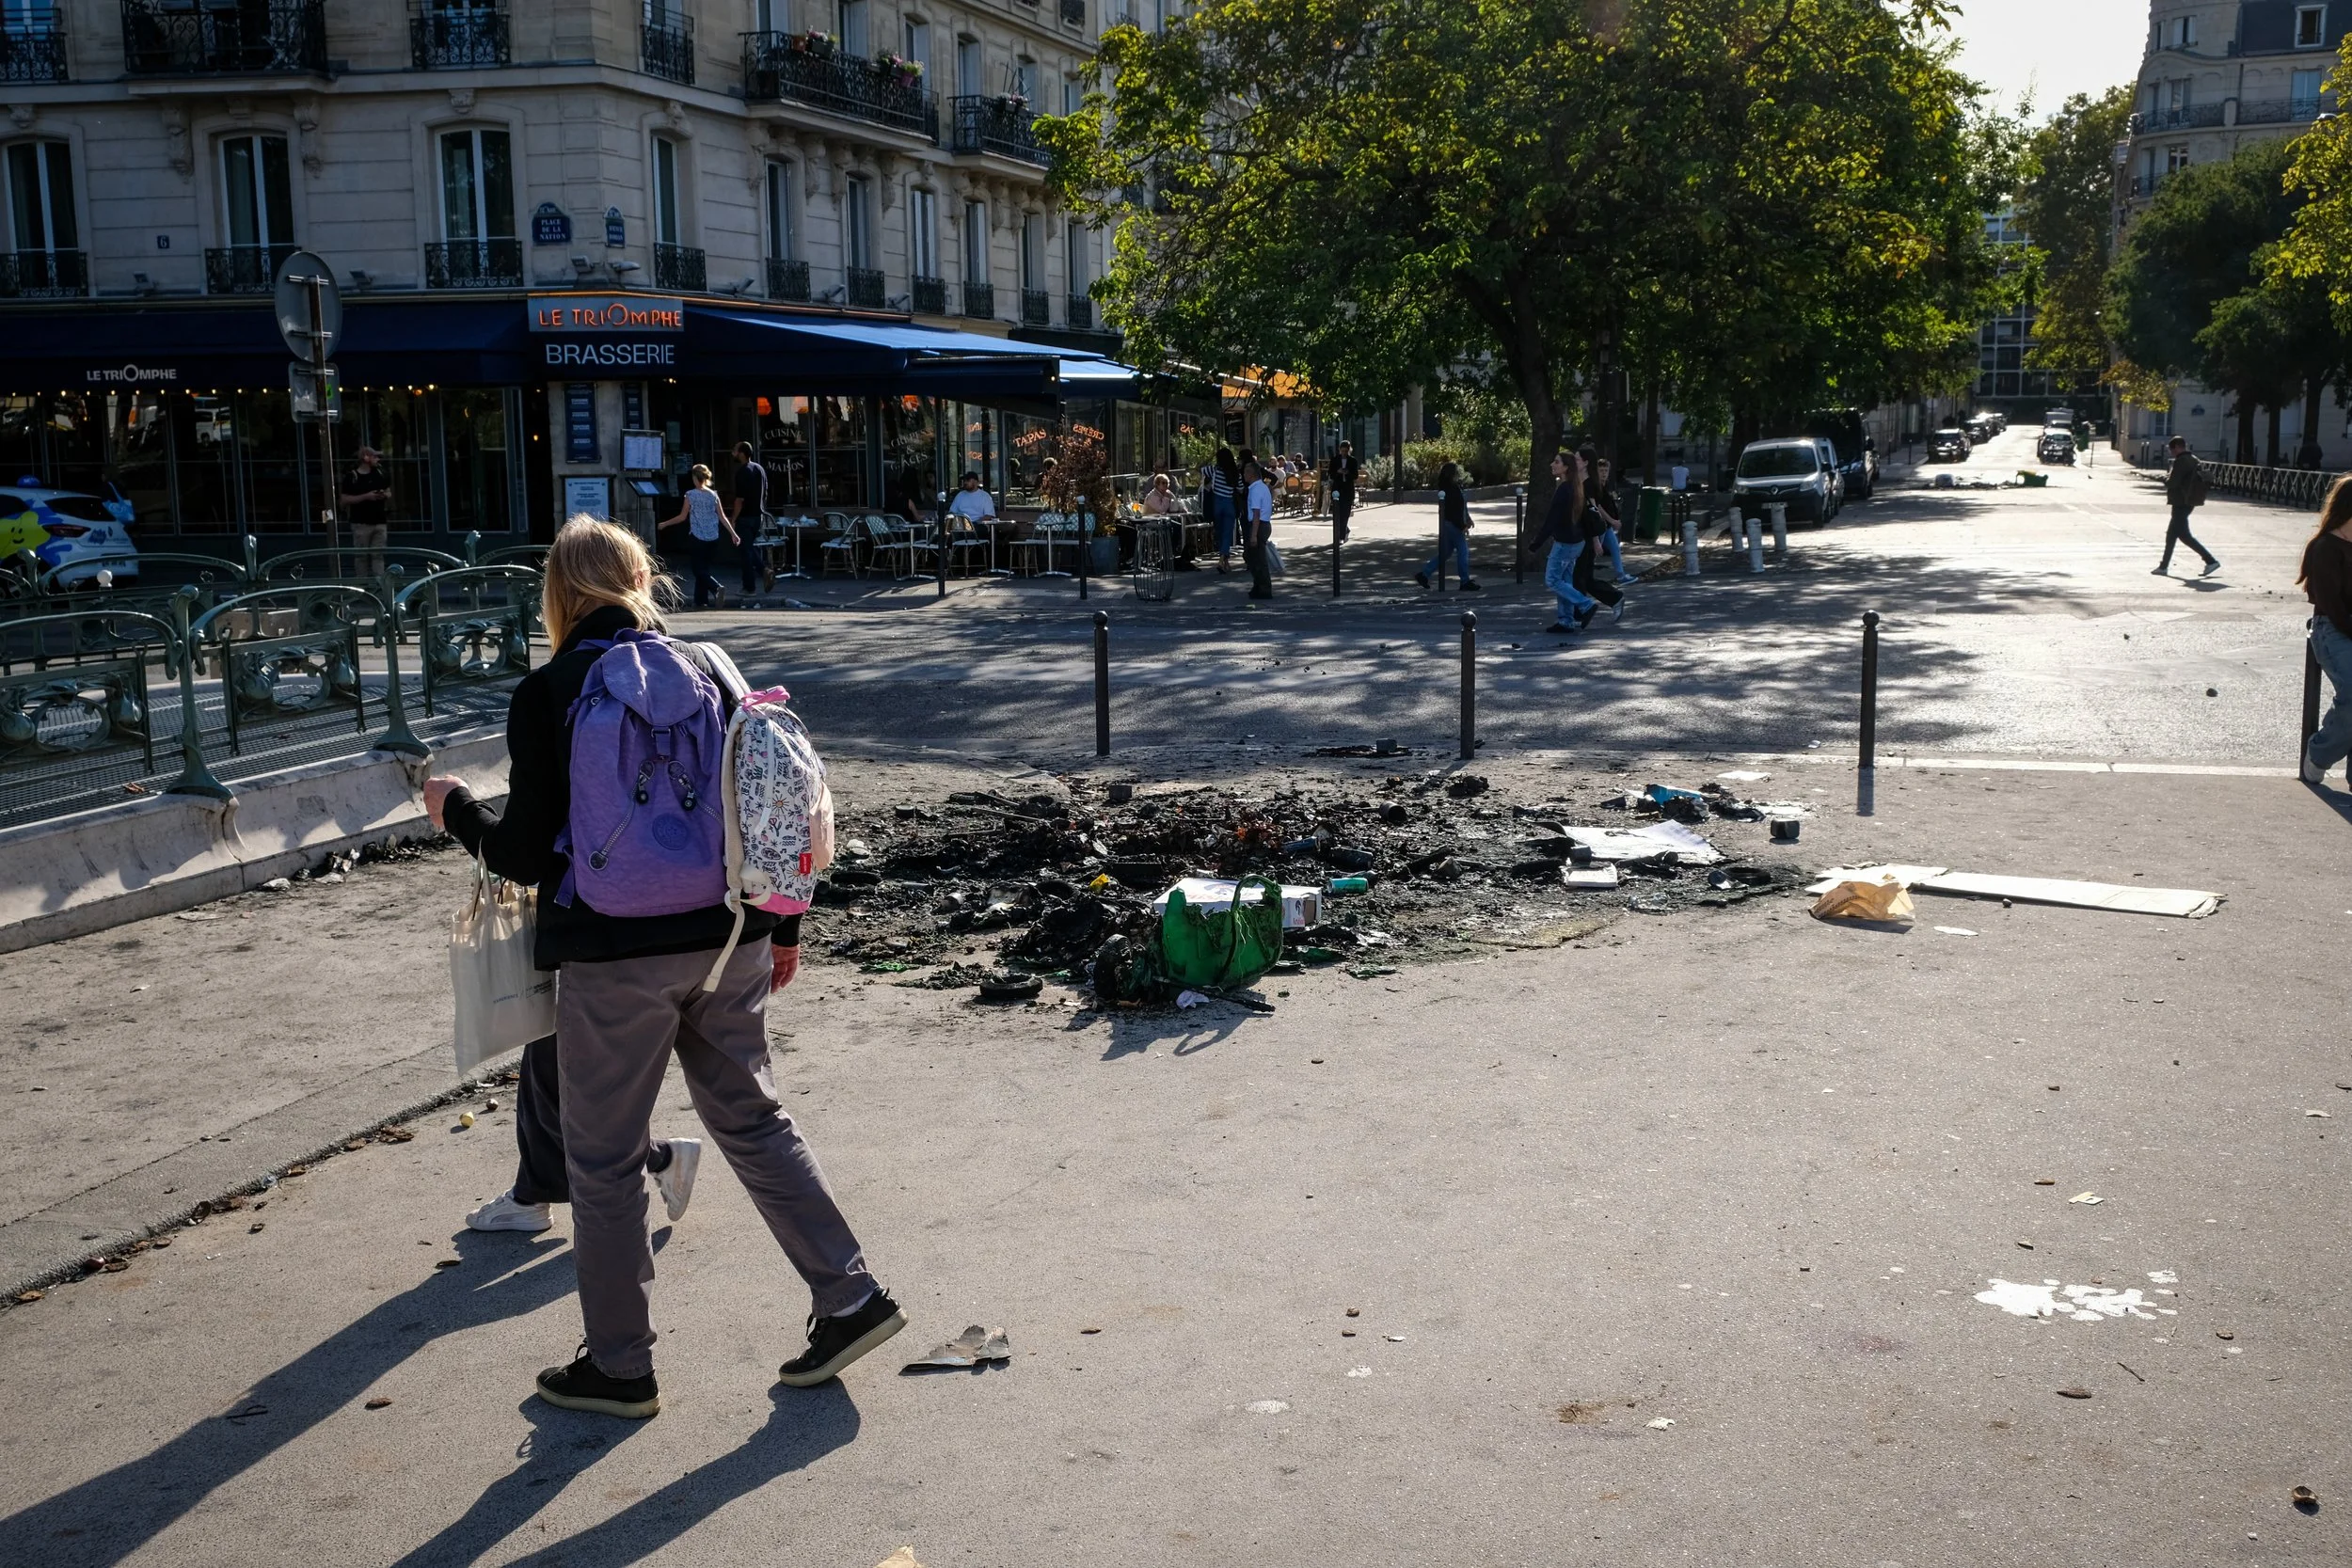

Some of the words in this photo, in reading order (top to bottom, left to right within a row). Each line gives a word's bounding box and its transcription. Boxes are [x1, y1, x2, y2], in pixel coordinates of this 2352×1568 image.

[160, 236, 167, 247] 6
[539, 309, 563, 326] LE
[572, 303, 682, 327] TRIOMPHE
[546, 343, 675, 365] BRASSERIE
[87, 370, 101, 382] LE
[104, 364, 177, 382] TRIOMPHE
[764, 428, 803, 440] CUISINE
[1012, 429, 1047, 448] TAPAS
